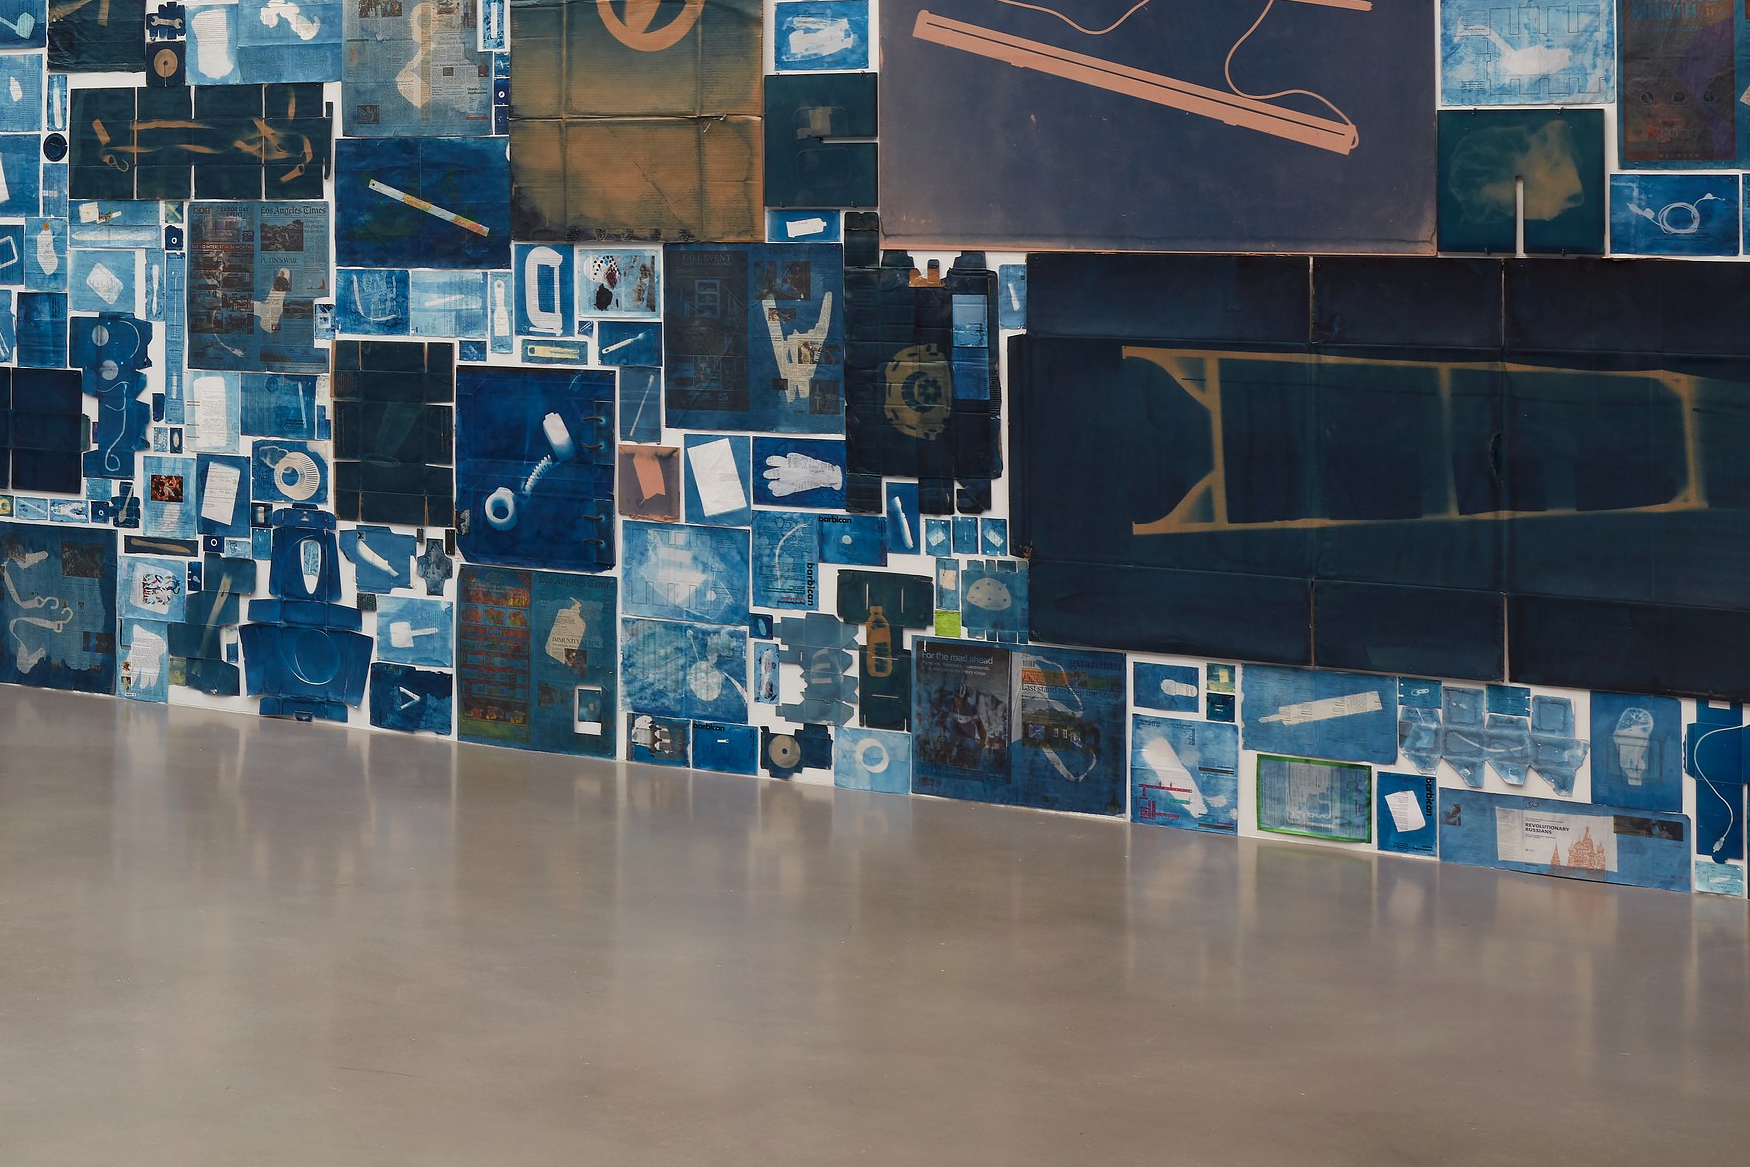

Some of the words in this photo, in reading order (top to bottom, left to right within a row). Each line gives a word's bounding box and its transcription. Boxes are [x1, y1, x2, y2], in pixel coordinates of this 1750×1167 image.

[1632, 3, 1697, 19] MONTH
[260, 206, 275, 215] Los
[276, 206, 303, 216] Angeles
[303, 205, 326, 215] Times
[261, 257, 281, 265] PUTIN'S
[282, 257, 298, 265] WAR
[818, 515, 852, 524] barbican
[806, 562, 816, 607] barbican
[936, 652, 948, 661] the
[950, 653, 968, 663] road
[969, 655, 993, 665] ahead
[1069, 658, 1122, 672] guardian
[1038, 685, 1057, 694] stand
[693, 723, 725, 732] barbican
[1426, 777, 1434, 817] barbican
[1525, 822, 1570, 832] REVOLUTIONARY
[1525, 827, 1552, 835] RUSSIANS
